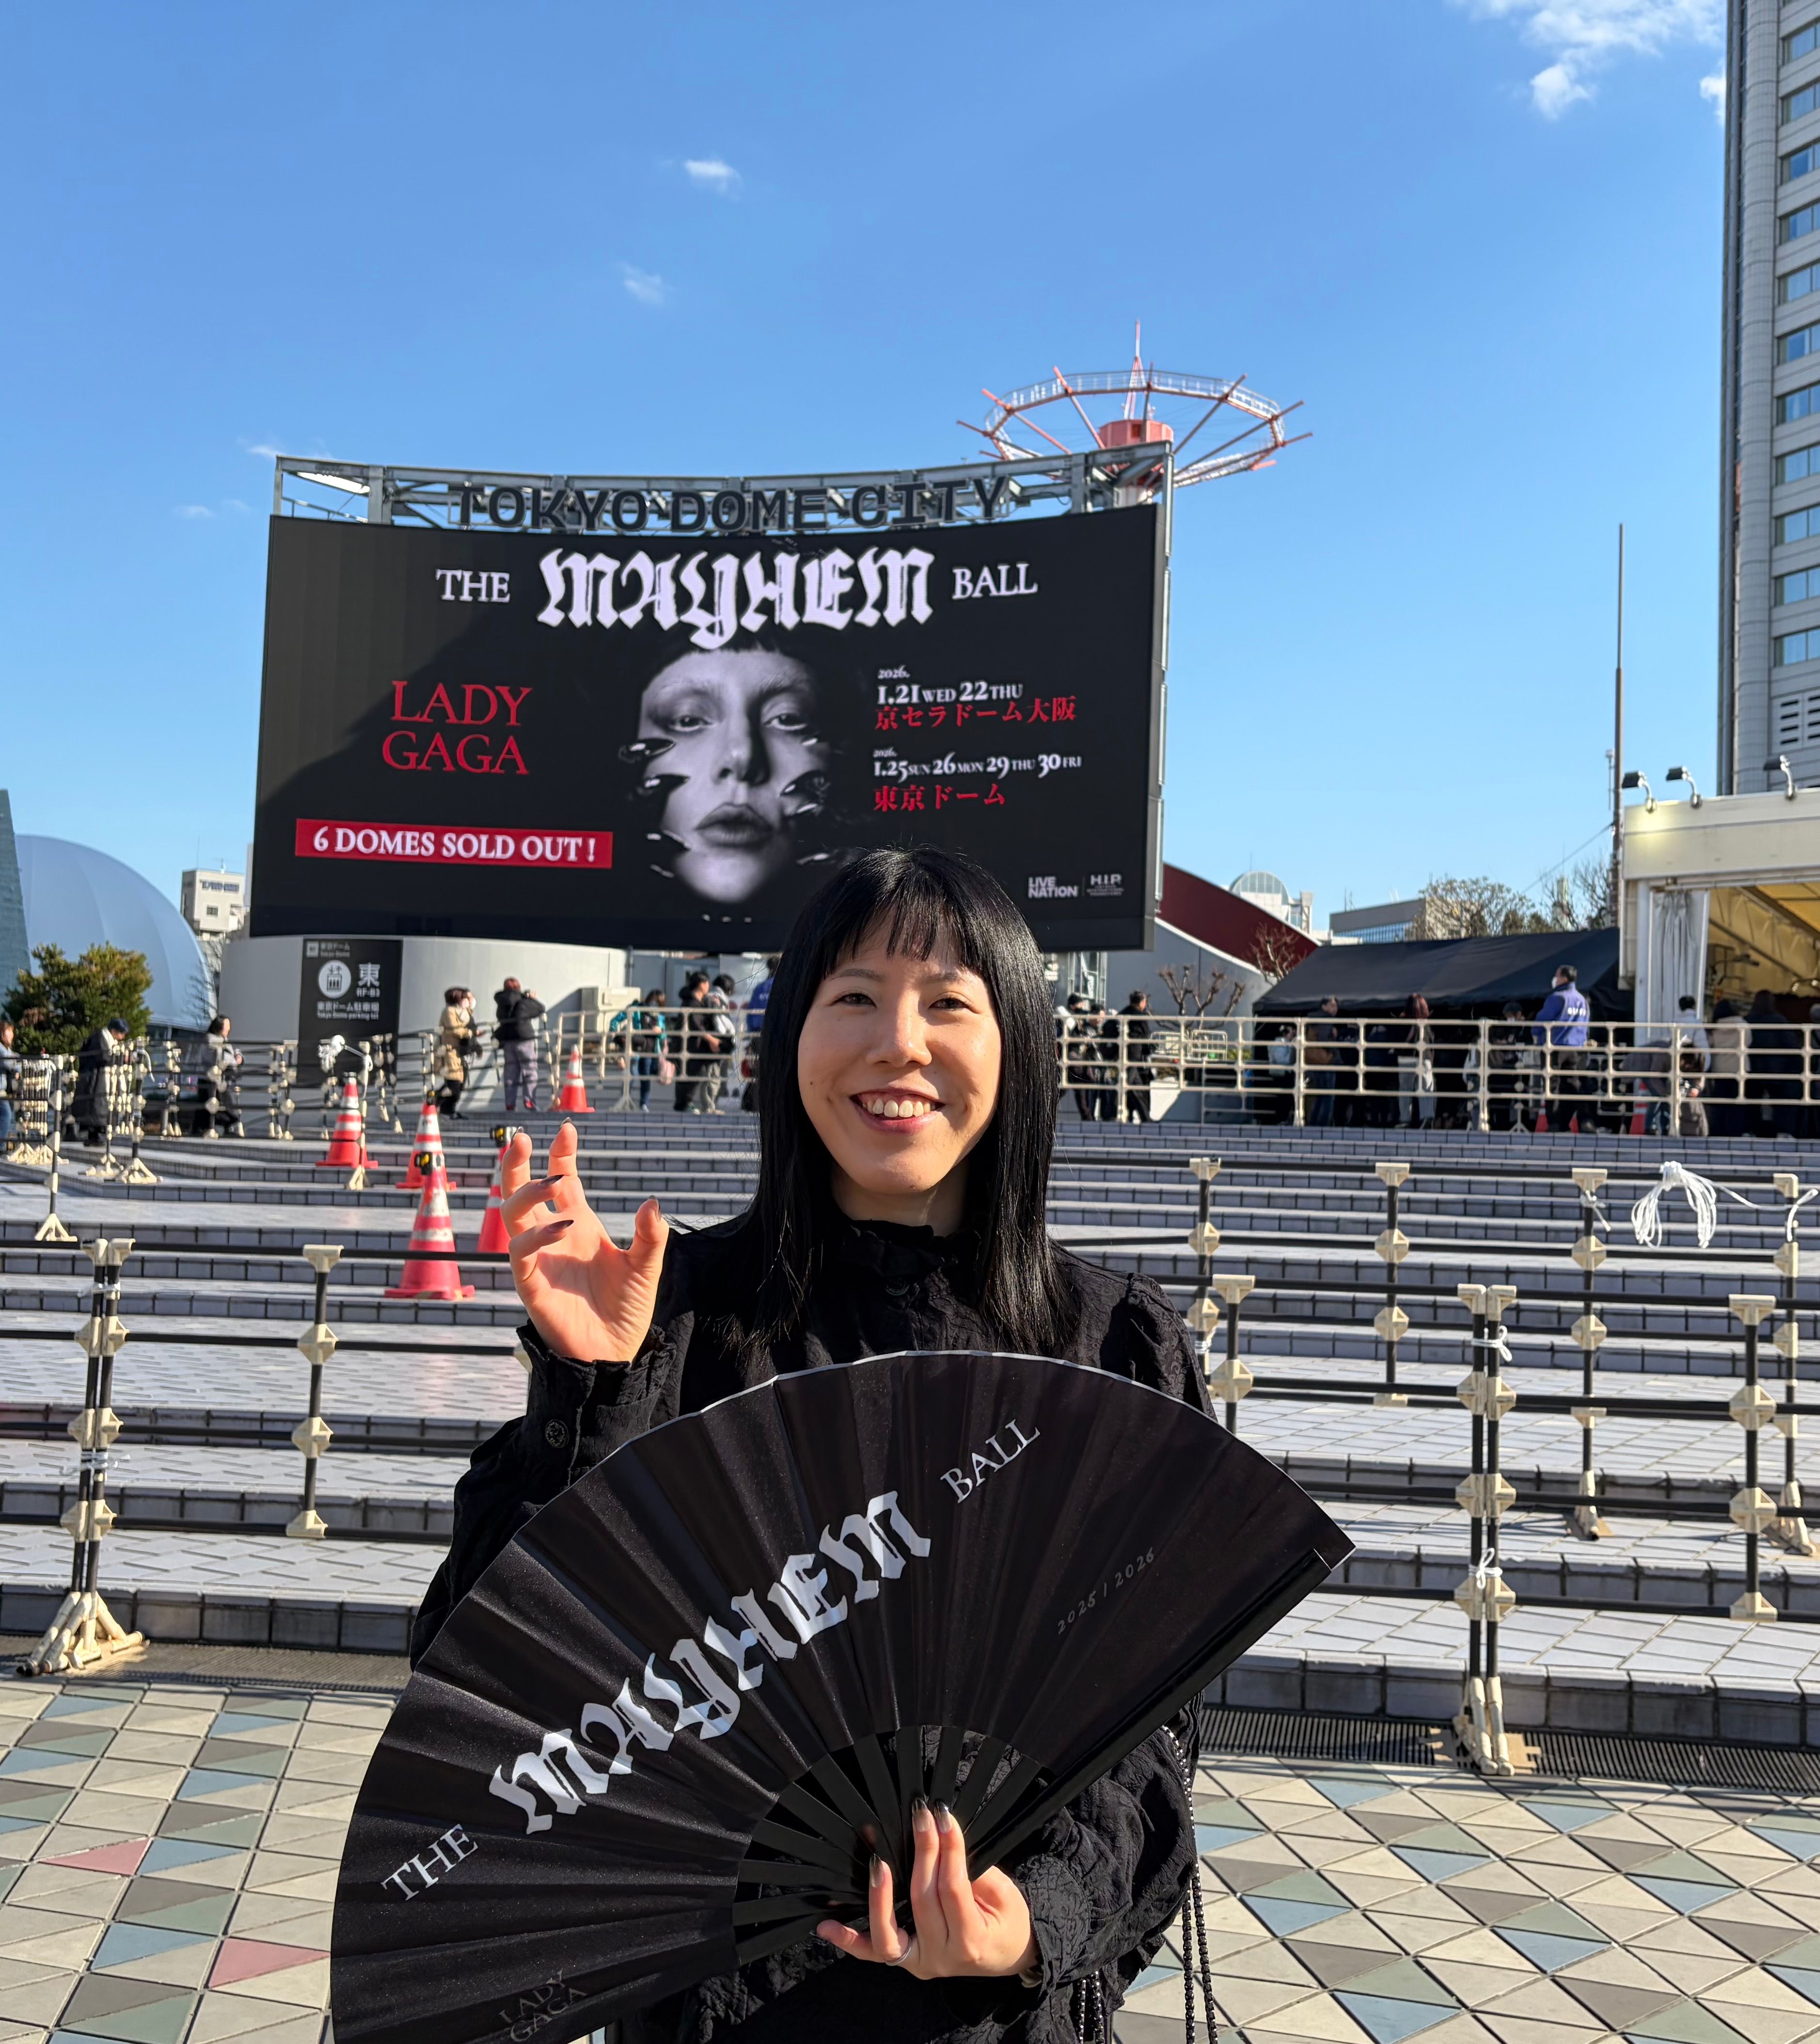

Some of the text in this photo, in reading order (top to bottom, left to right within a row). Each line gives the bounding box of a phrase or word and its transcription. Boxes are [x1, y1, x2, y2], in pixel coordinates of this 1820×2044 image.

[448, 476, 1010, 532] TOKYO DOME CITY
[435, 547, 1038, 650] THE MAYHEM BALL
[391, 680, 532, 726] LADY
[875, 695, 1076, 731] 京セラドーム大阪
[382, 731, 529, 775] GAGA
[874, 783, 1005, 813] 東京ドーム
[314, 826, 329, 851] 6
[334, 828, 435, 856] DOMES
[442, 832, 515, 859] SOLD
[1028, 876, 1056, 887] LIVE
[1028, 886, 1078, 898] NATION
[358, 962, 380, 988] 東
[1115, 1547, 1155, 1588] 2026
[380, 1419, 1040, 1901] THE MAYHEM BALL
[499, 1967, 566, 2023] LADY
[510, 1988, 587, 2042] GAGA
